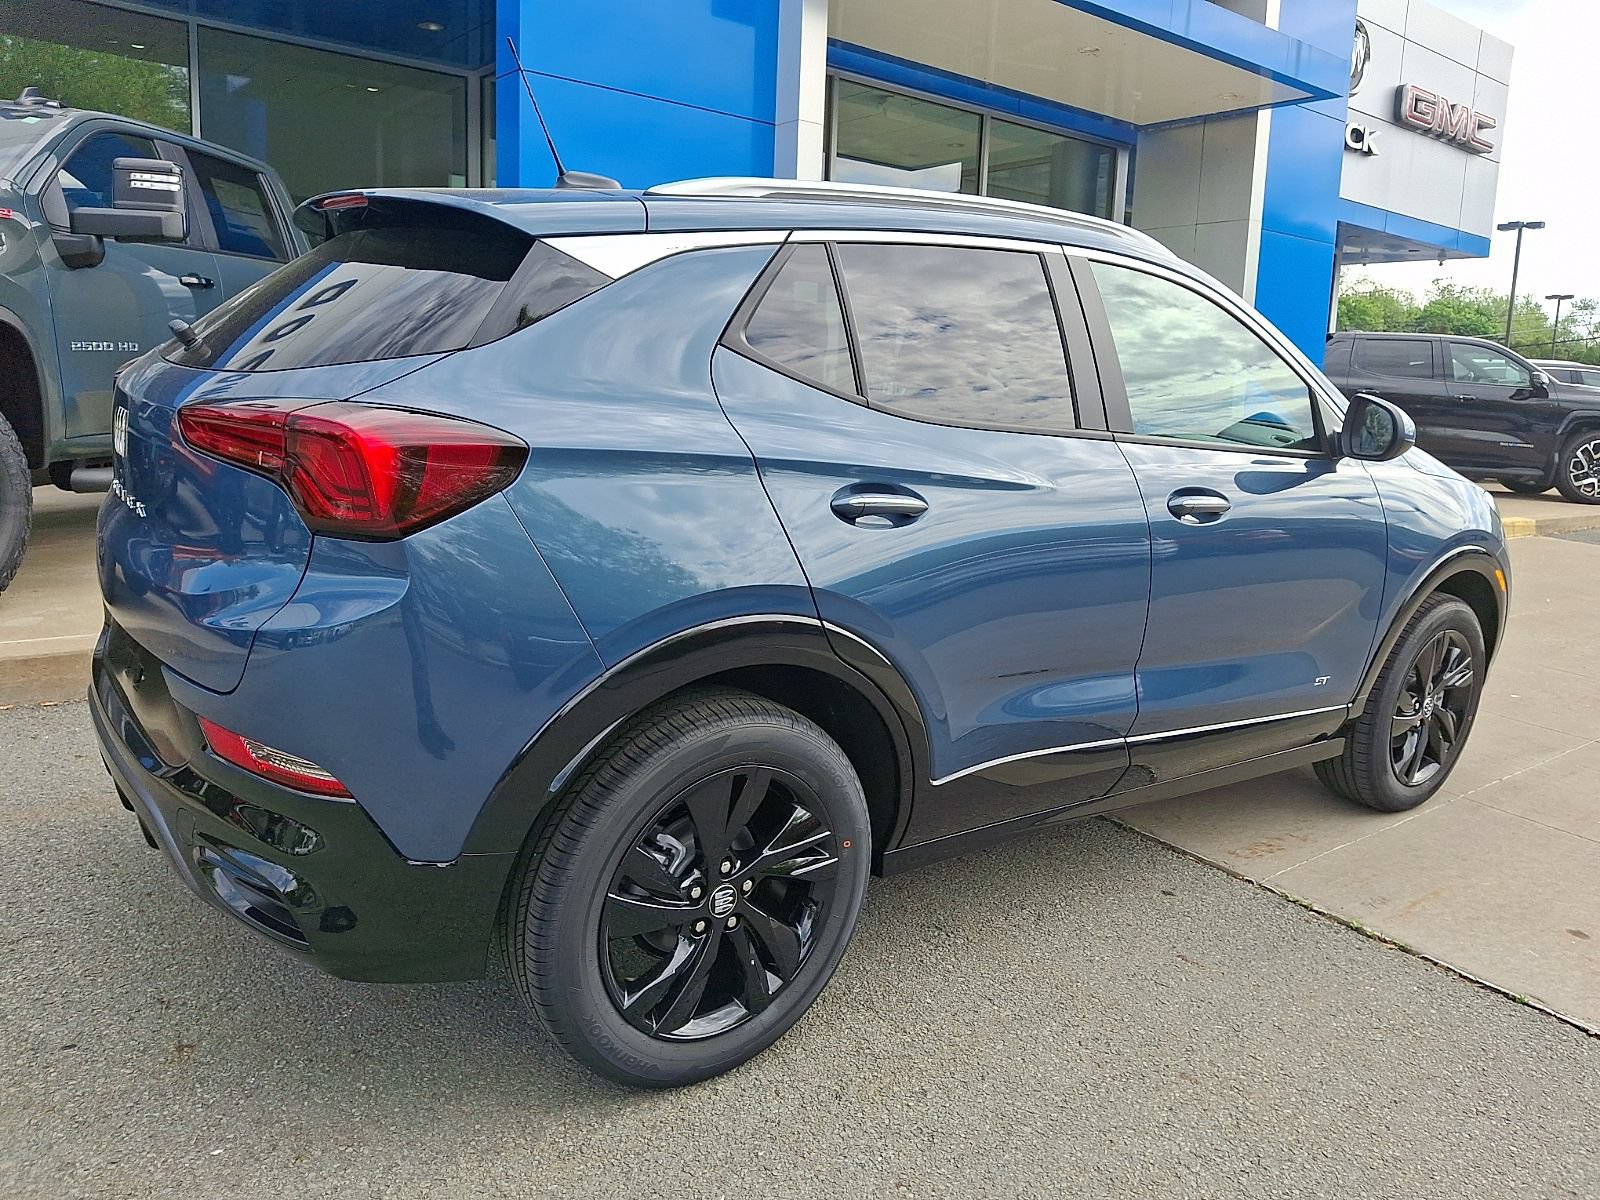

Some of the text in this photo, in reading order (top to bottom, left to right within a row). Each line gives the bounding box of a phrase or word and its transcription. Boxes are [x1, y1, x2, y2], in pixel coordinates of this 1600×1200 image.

[1397, 83, 1496, 154] GMC
[71, 341, 139, 352] 2500 HD
[1314, 675, 1331, 686] ST
